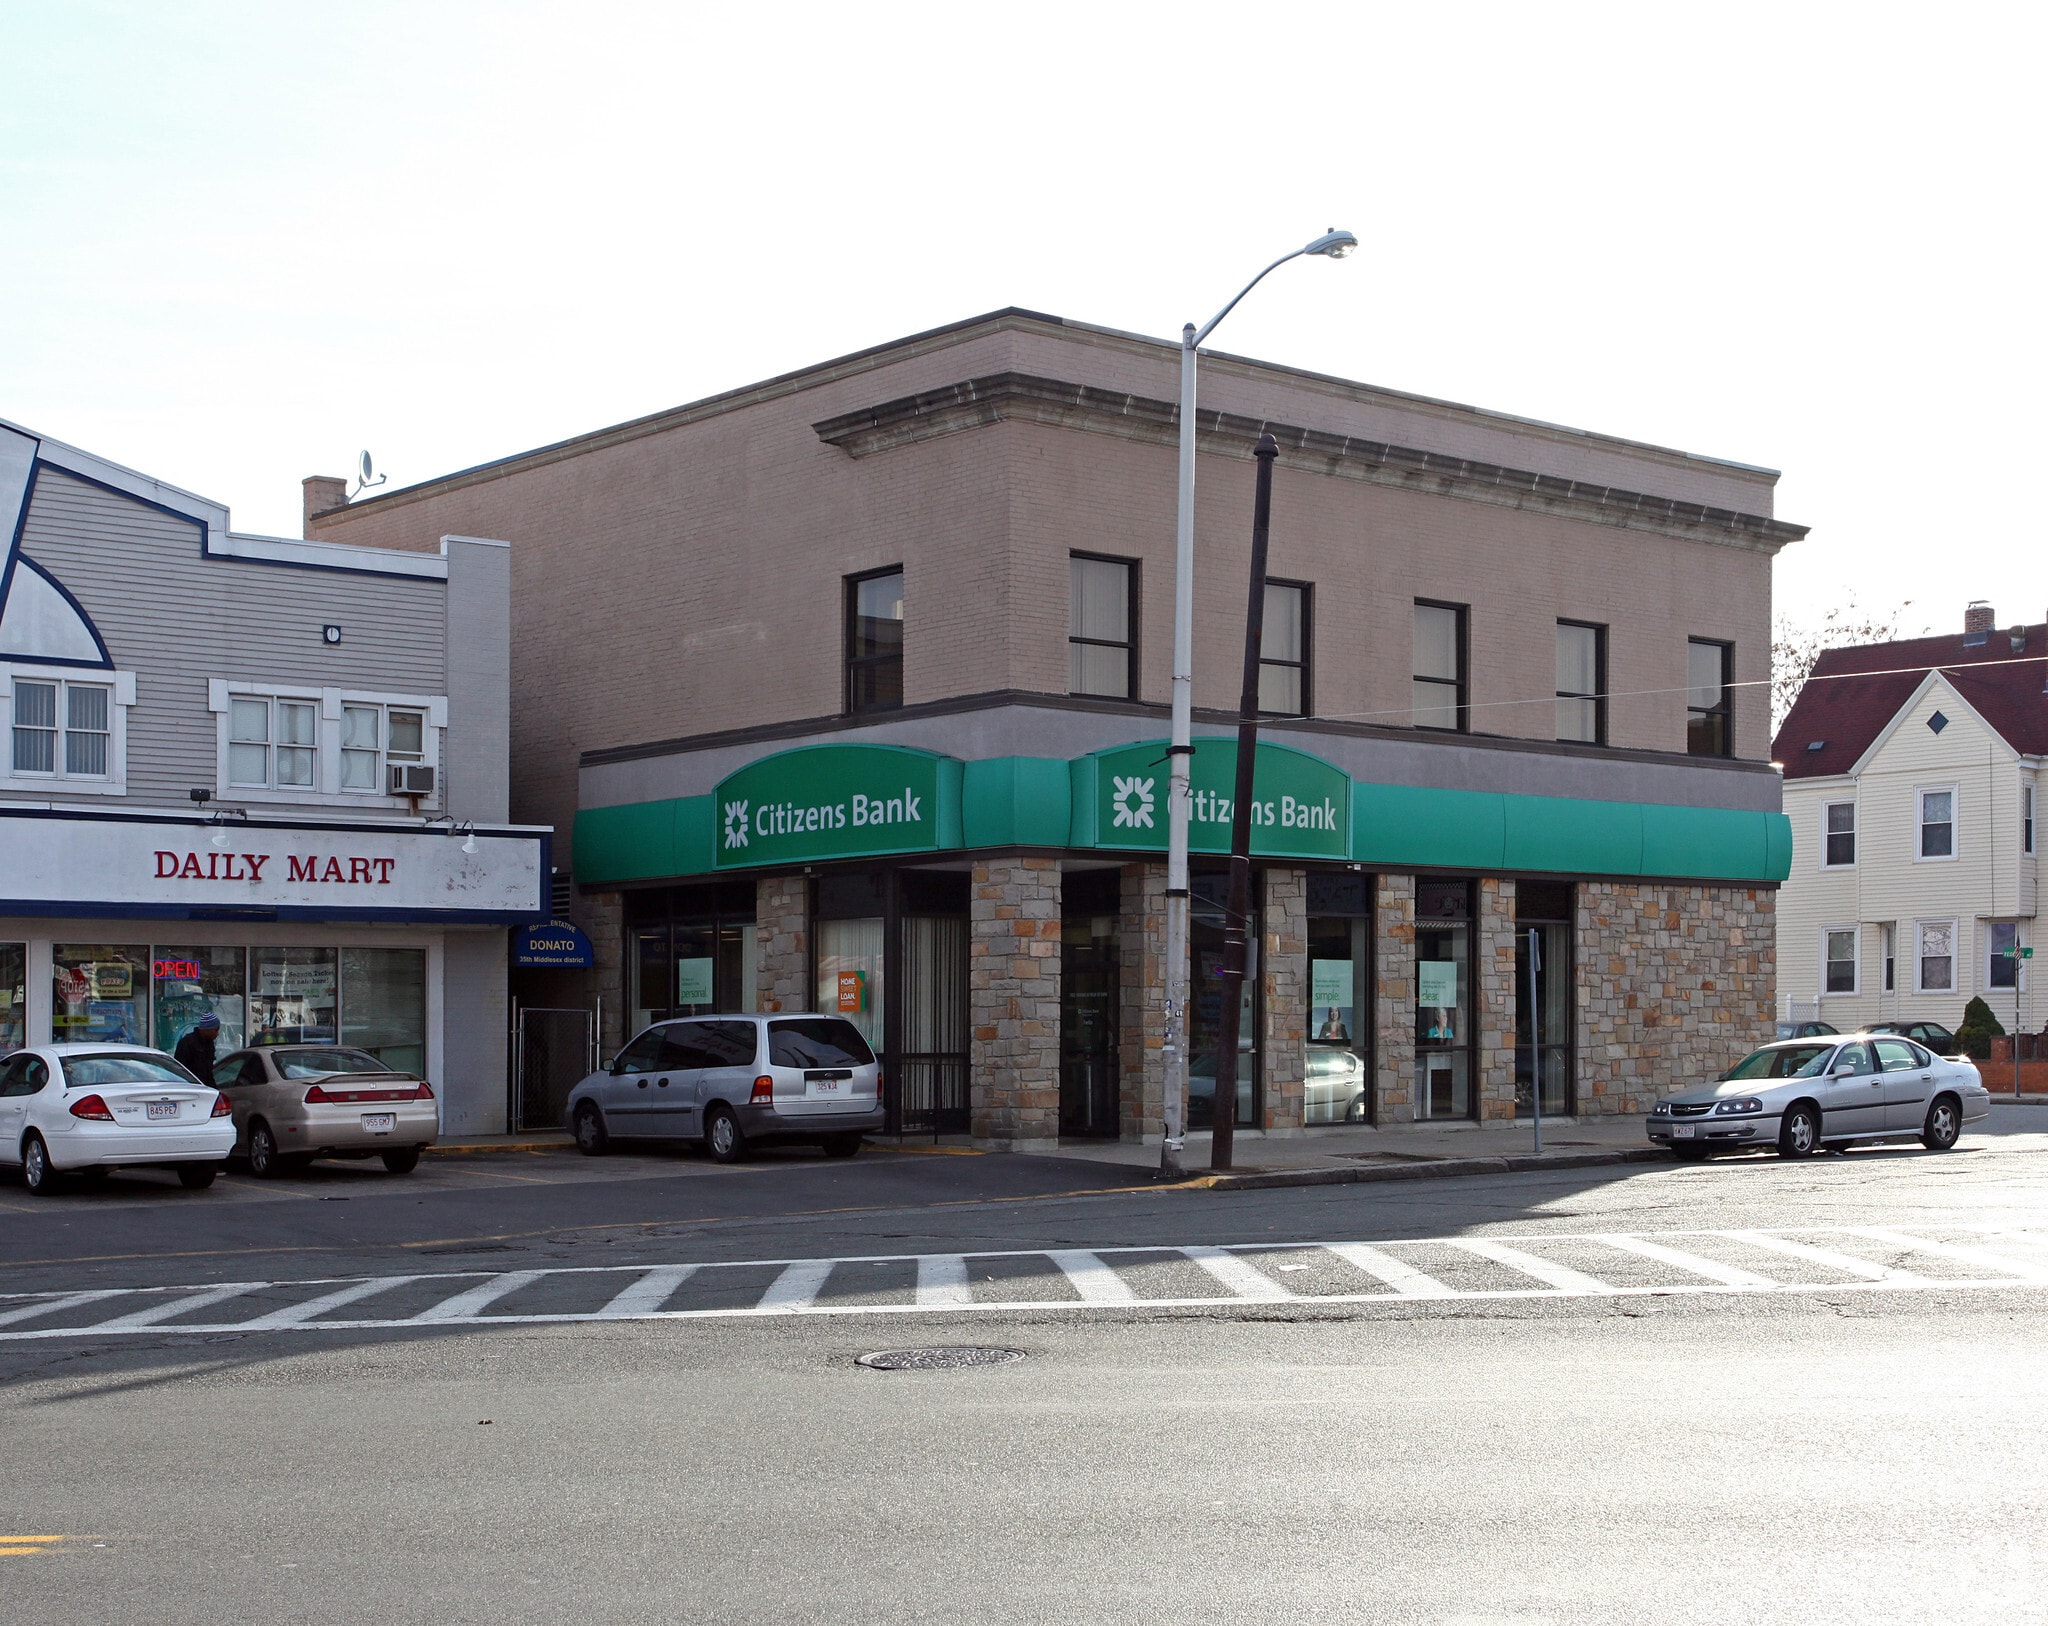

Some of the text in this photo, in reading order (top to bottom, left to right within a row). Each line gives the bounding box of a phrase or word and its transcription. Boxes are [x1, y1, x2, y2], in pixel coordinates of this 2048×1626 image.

[756, 787, 922, 836] Citizens Bank
[1167, 790, 1337, 831] itizns Bank
[154, 851, 395, 884] DAILY MART
[529, 940, 575, 951] DONATO
[152, 961, 198, 979] OPEN
[840, 977, 856, 985] HOME
[150, 1106, 163, 1116] 845
[164, 1105, 177, 1115] PE7
[366, 1118, 378, 1127] 955
